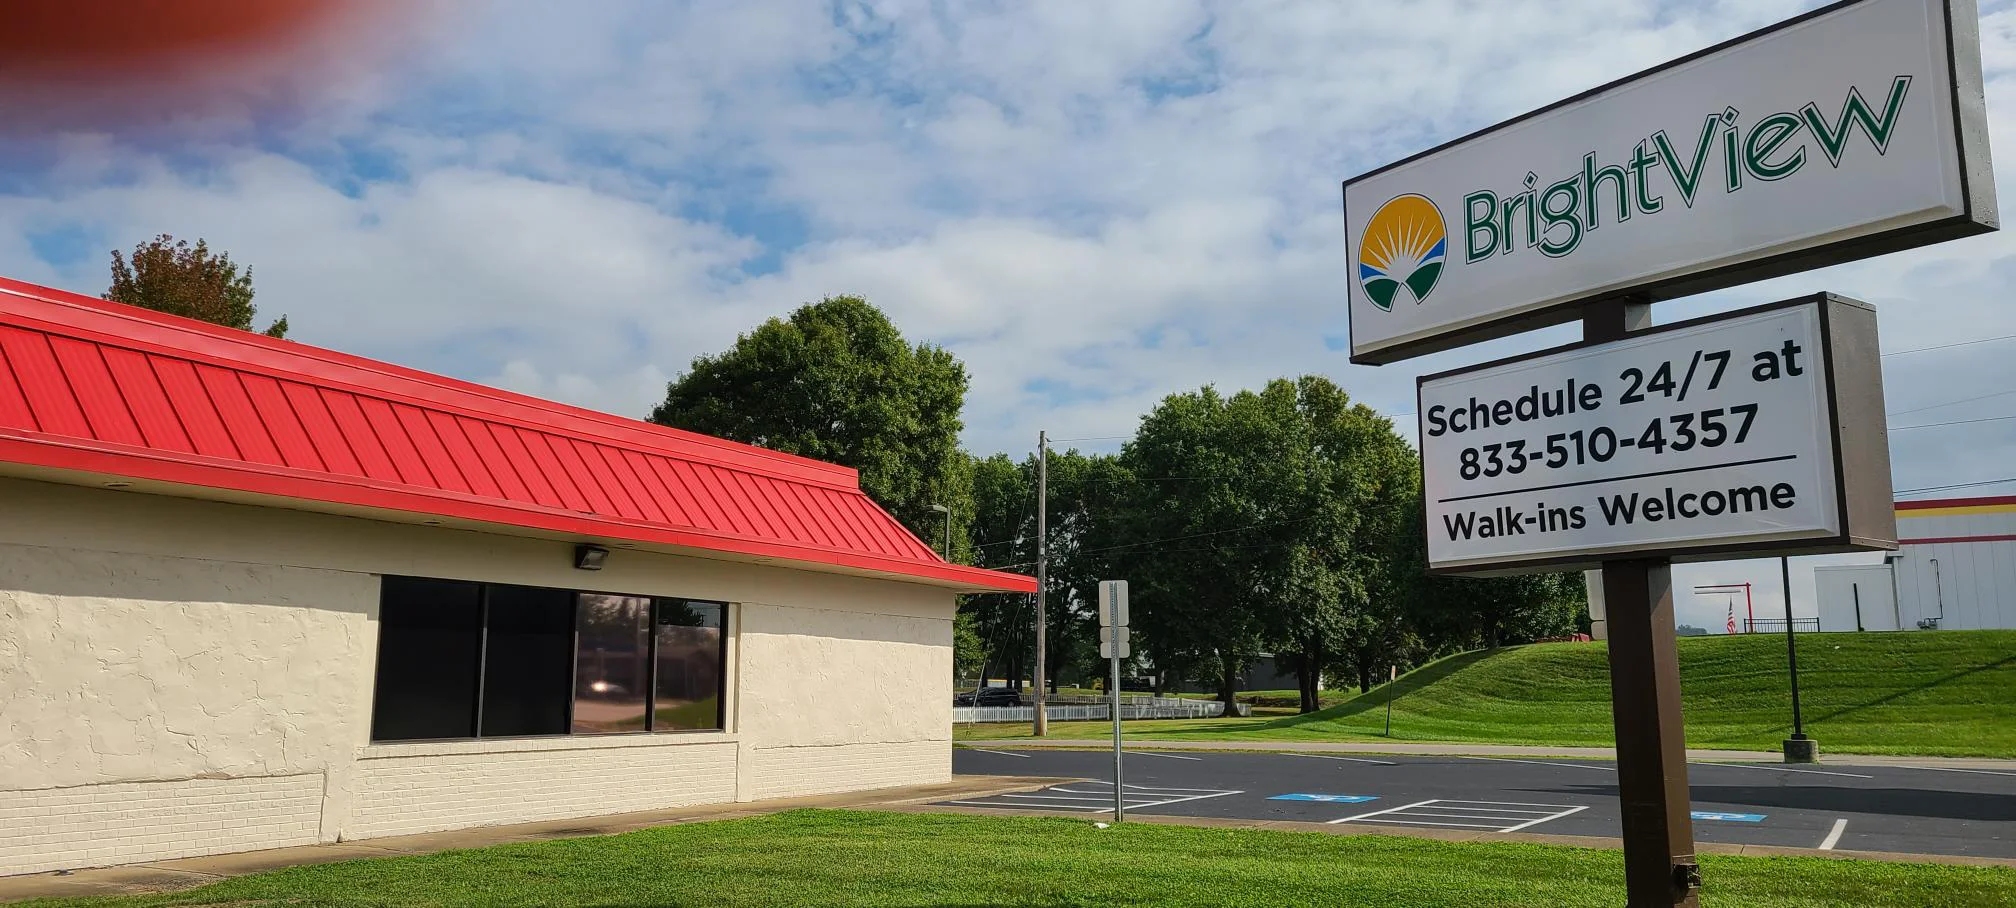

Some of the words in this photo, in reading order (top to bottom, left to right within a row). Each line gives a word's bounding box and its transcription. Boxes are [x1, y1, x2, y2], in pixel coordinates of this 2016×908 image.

[1463, 75, 1912, 265] BrightView
[1427, 378, 1602, 437] Schedule
[1619, 350, 1731, 406] 24/7
[1751, 340, 1803, 382] at
[1460, 403, 1758, 480] 833-510-4357
[1443, 502, 1586, 541] Walk-ins
[1598, 482, 1796, 526] Welcome
